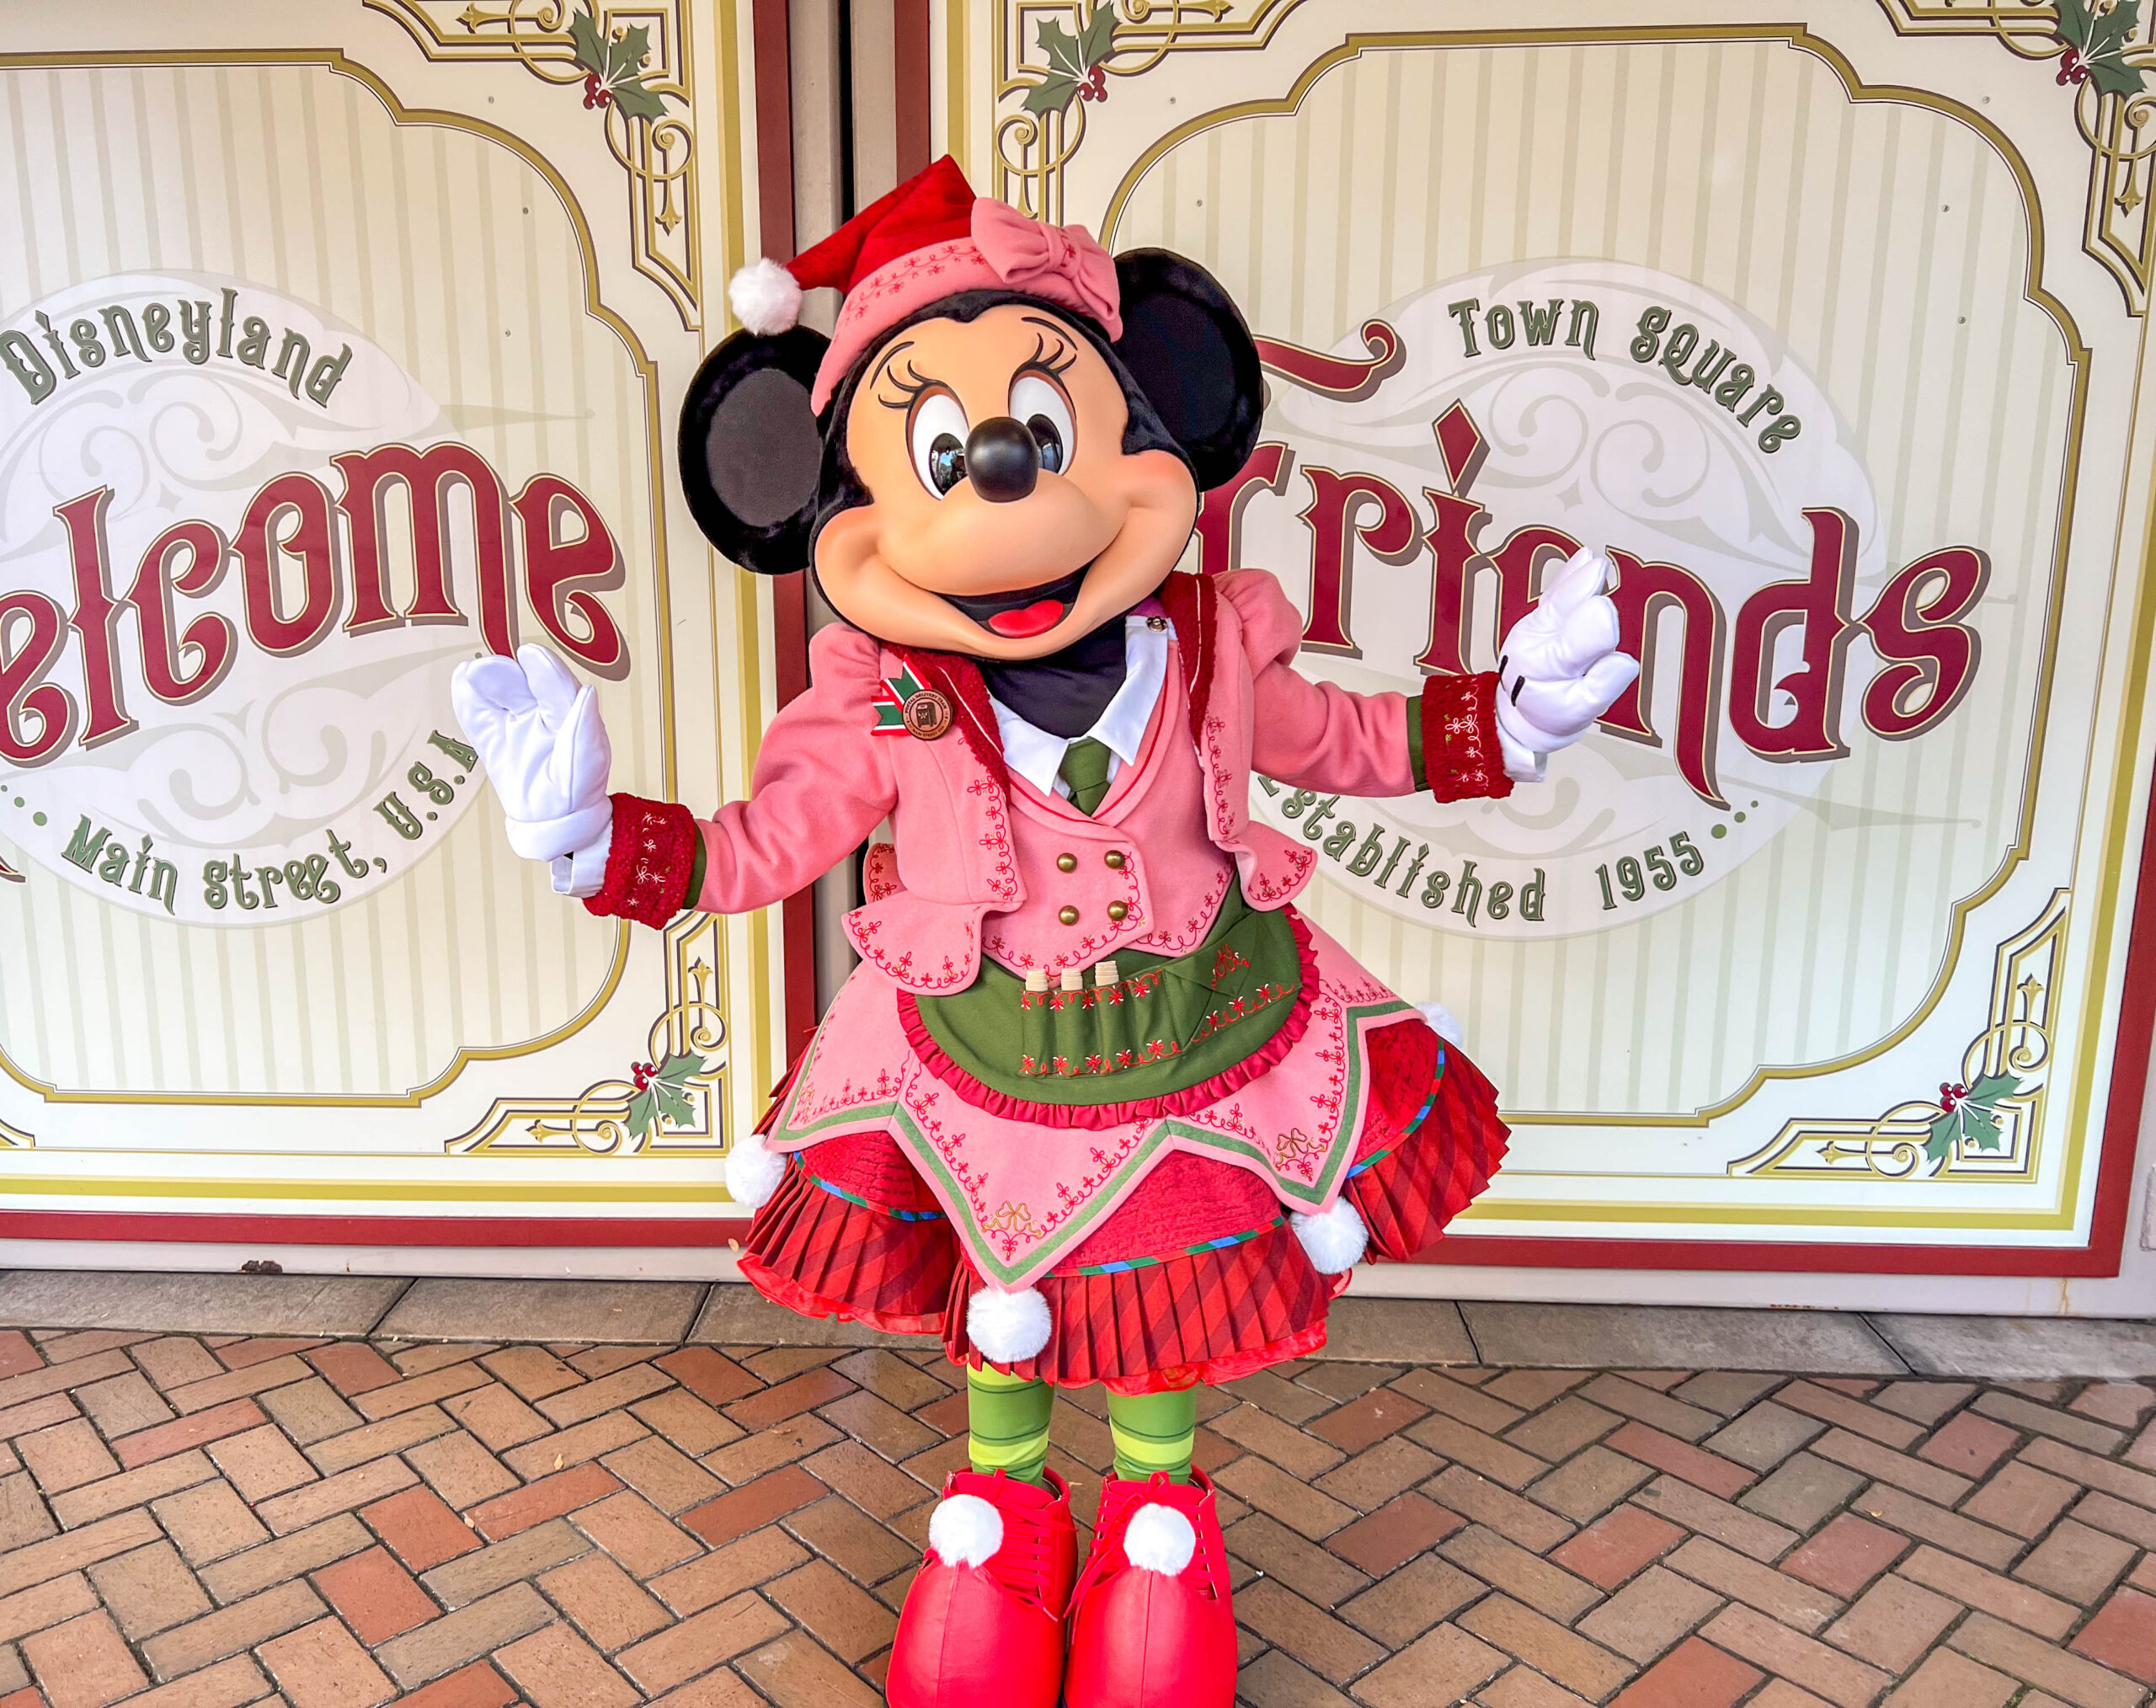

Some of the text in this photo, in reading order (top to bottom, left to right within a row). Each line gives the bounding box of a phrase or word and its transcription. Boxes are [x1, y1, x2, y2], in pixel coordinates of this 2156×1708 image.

[0, 287, 352, 408] Disneyland
[1448, 297, 1801, 453] Town Square
[0, 441, 630, 767] elcome
[905, 697, 915, 713] POSTAL
[937, 697, 947, 709] TEAM
[61, 814, 175, 915] Main
[202, 829, 387, 910] Street,
[1595, 831, 1705, 910] 1955
